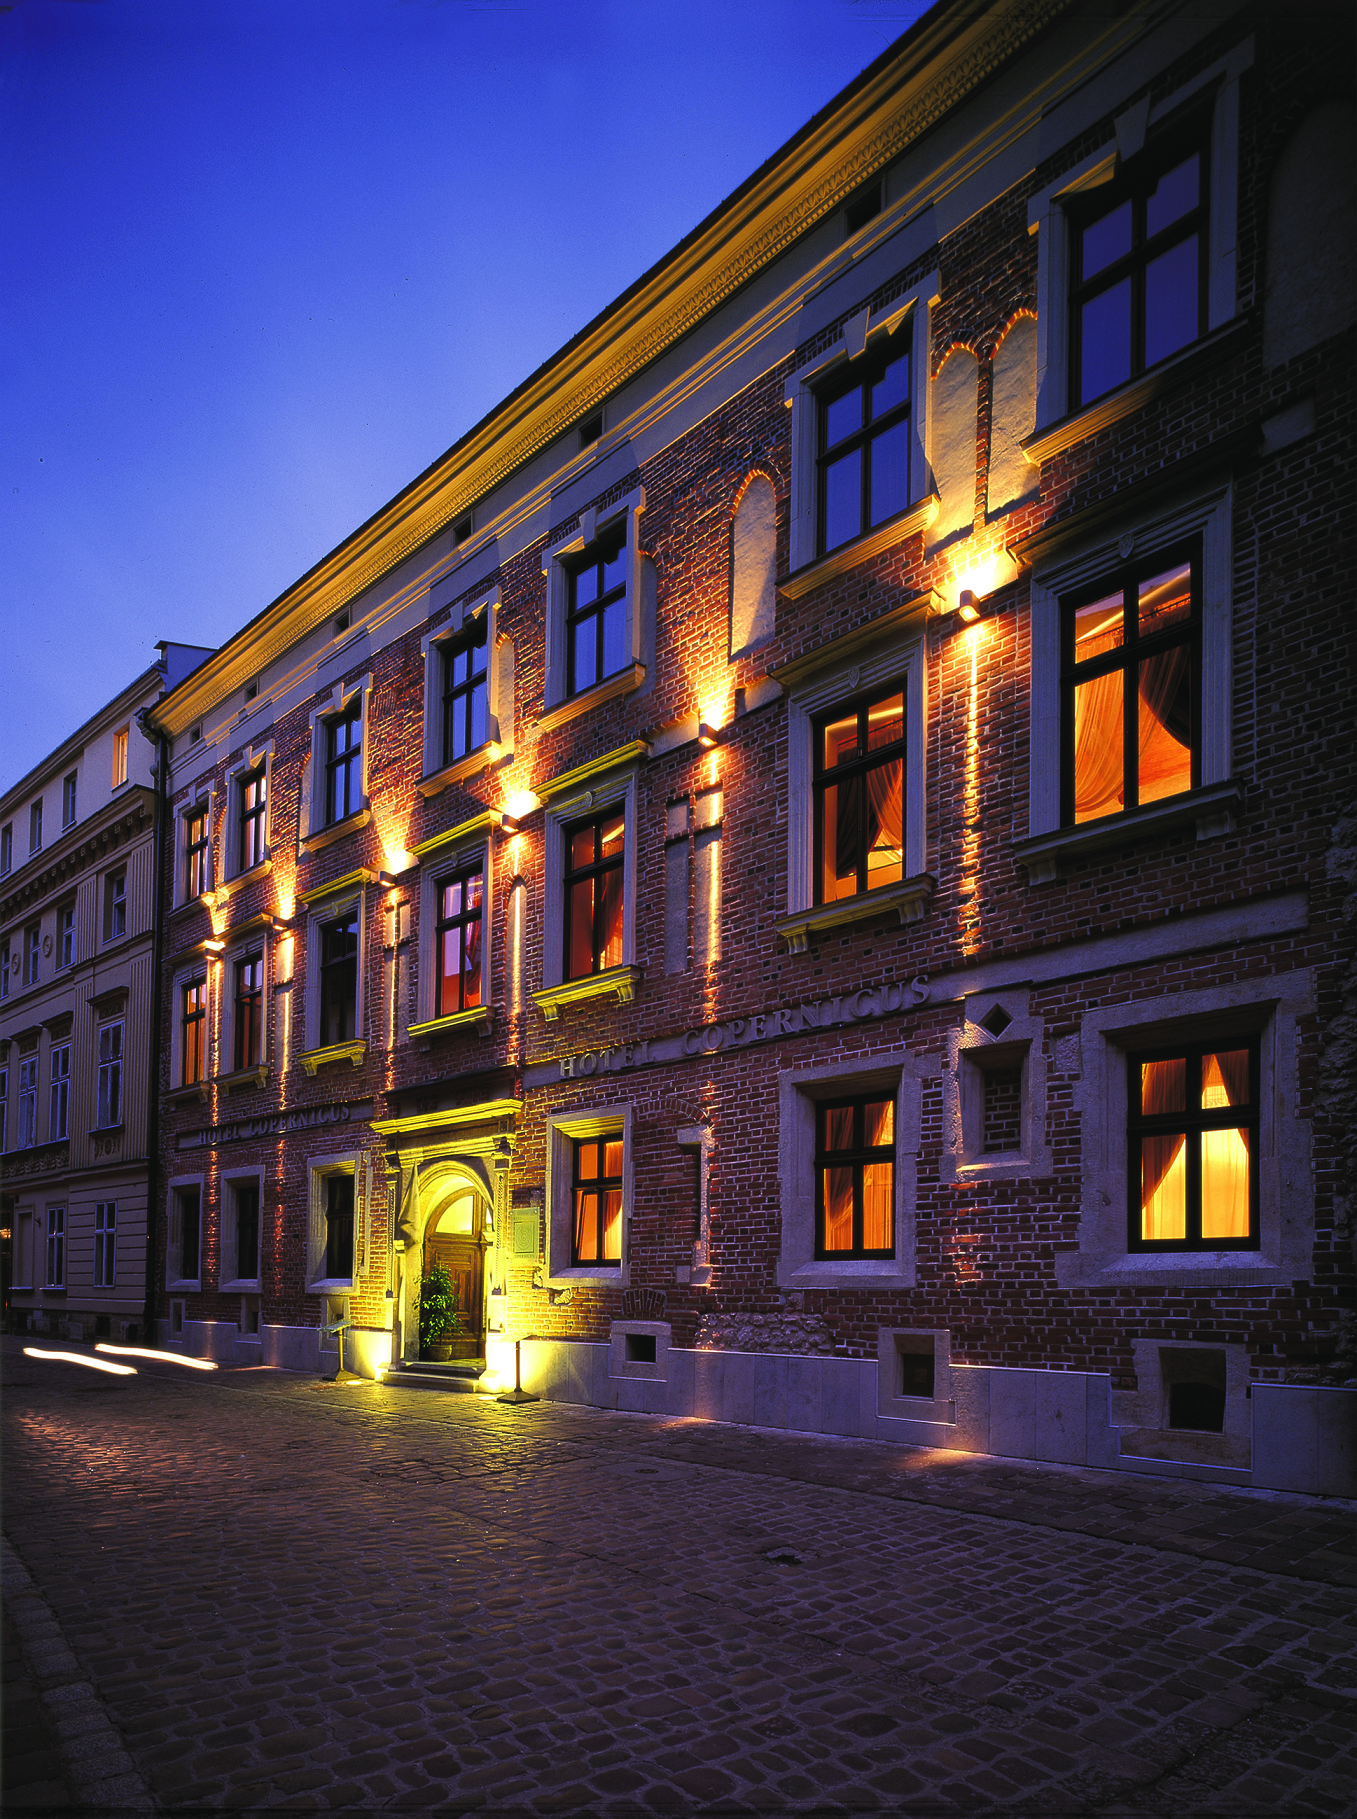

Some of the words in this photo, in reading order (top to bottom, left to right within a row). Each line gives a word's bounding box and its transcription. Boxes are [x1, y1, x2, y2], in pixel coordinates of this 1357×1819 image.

[559, 1041, 656, 1080] HOTEL
[682, 975, 930, 1056] COPERNICUS
[200, 1125, 241, 1146] HOTEL
[250, 1104, 350, 1136] COPERNICUS
